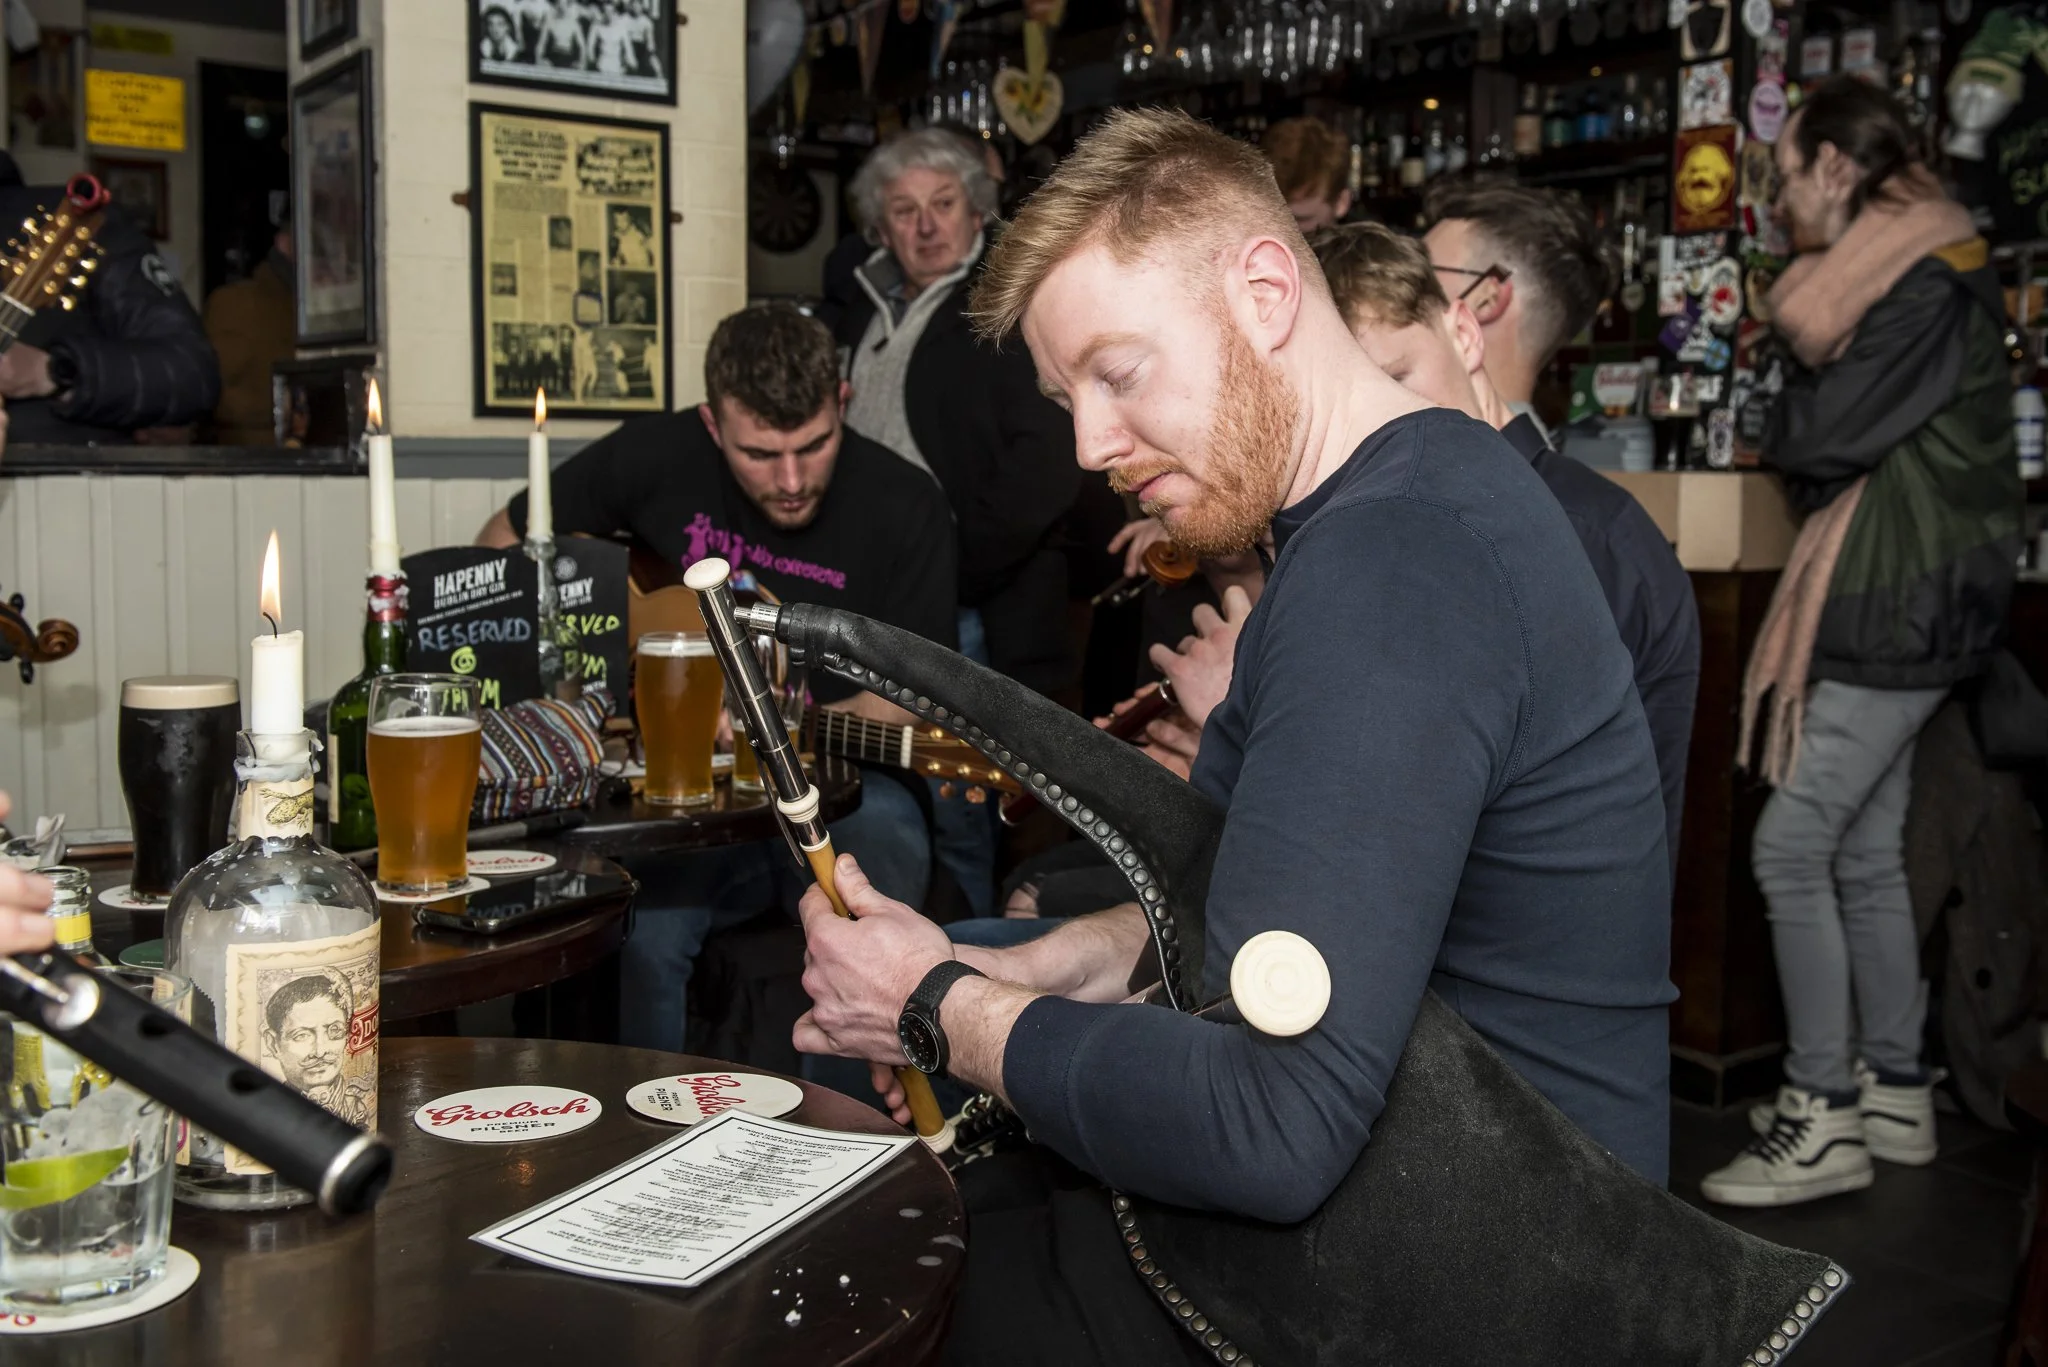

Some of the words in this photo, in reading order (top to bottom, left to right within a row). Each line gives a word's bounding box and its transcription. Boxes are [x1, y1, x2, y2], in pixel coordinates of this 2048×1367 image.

[434, 589, 470, 610] DUBLIN
[470, 586, 488, 600] DRY
[488, 580, 507, 595] GIN
[557, 576, 594, 602] ENNY
[417, 617, 532, 653] RESERVED
[425, 1096, 592, 1128] Grolsch
[655, 1087, 674, 1112] PILSNER
[470, 1121, 557, 1133] PILSNER
[486, 1119, 541, 1128] PREMIUM
[498, 1127, 530, 1135] BEER
